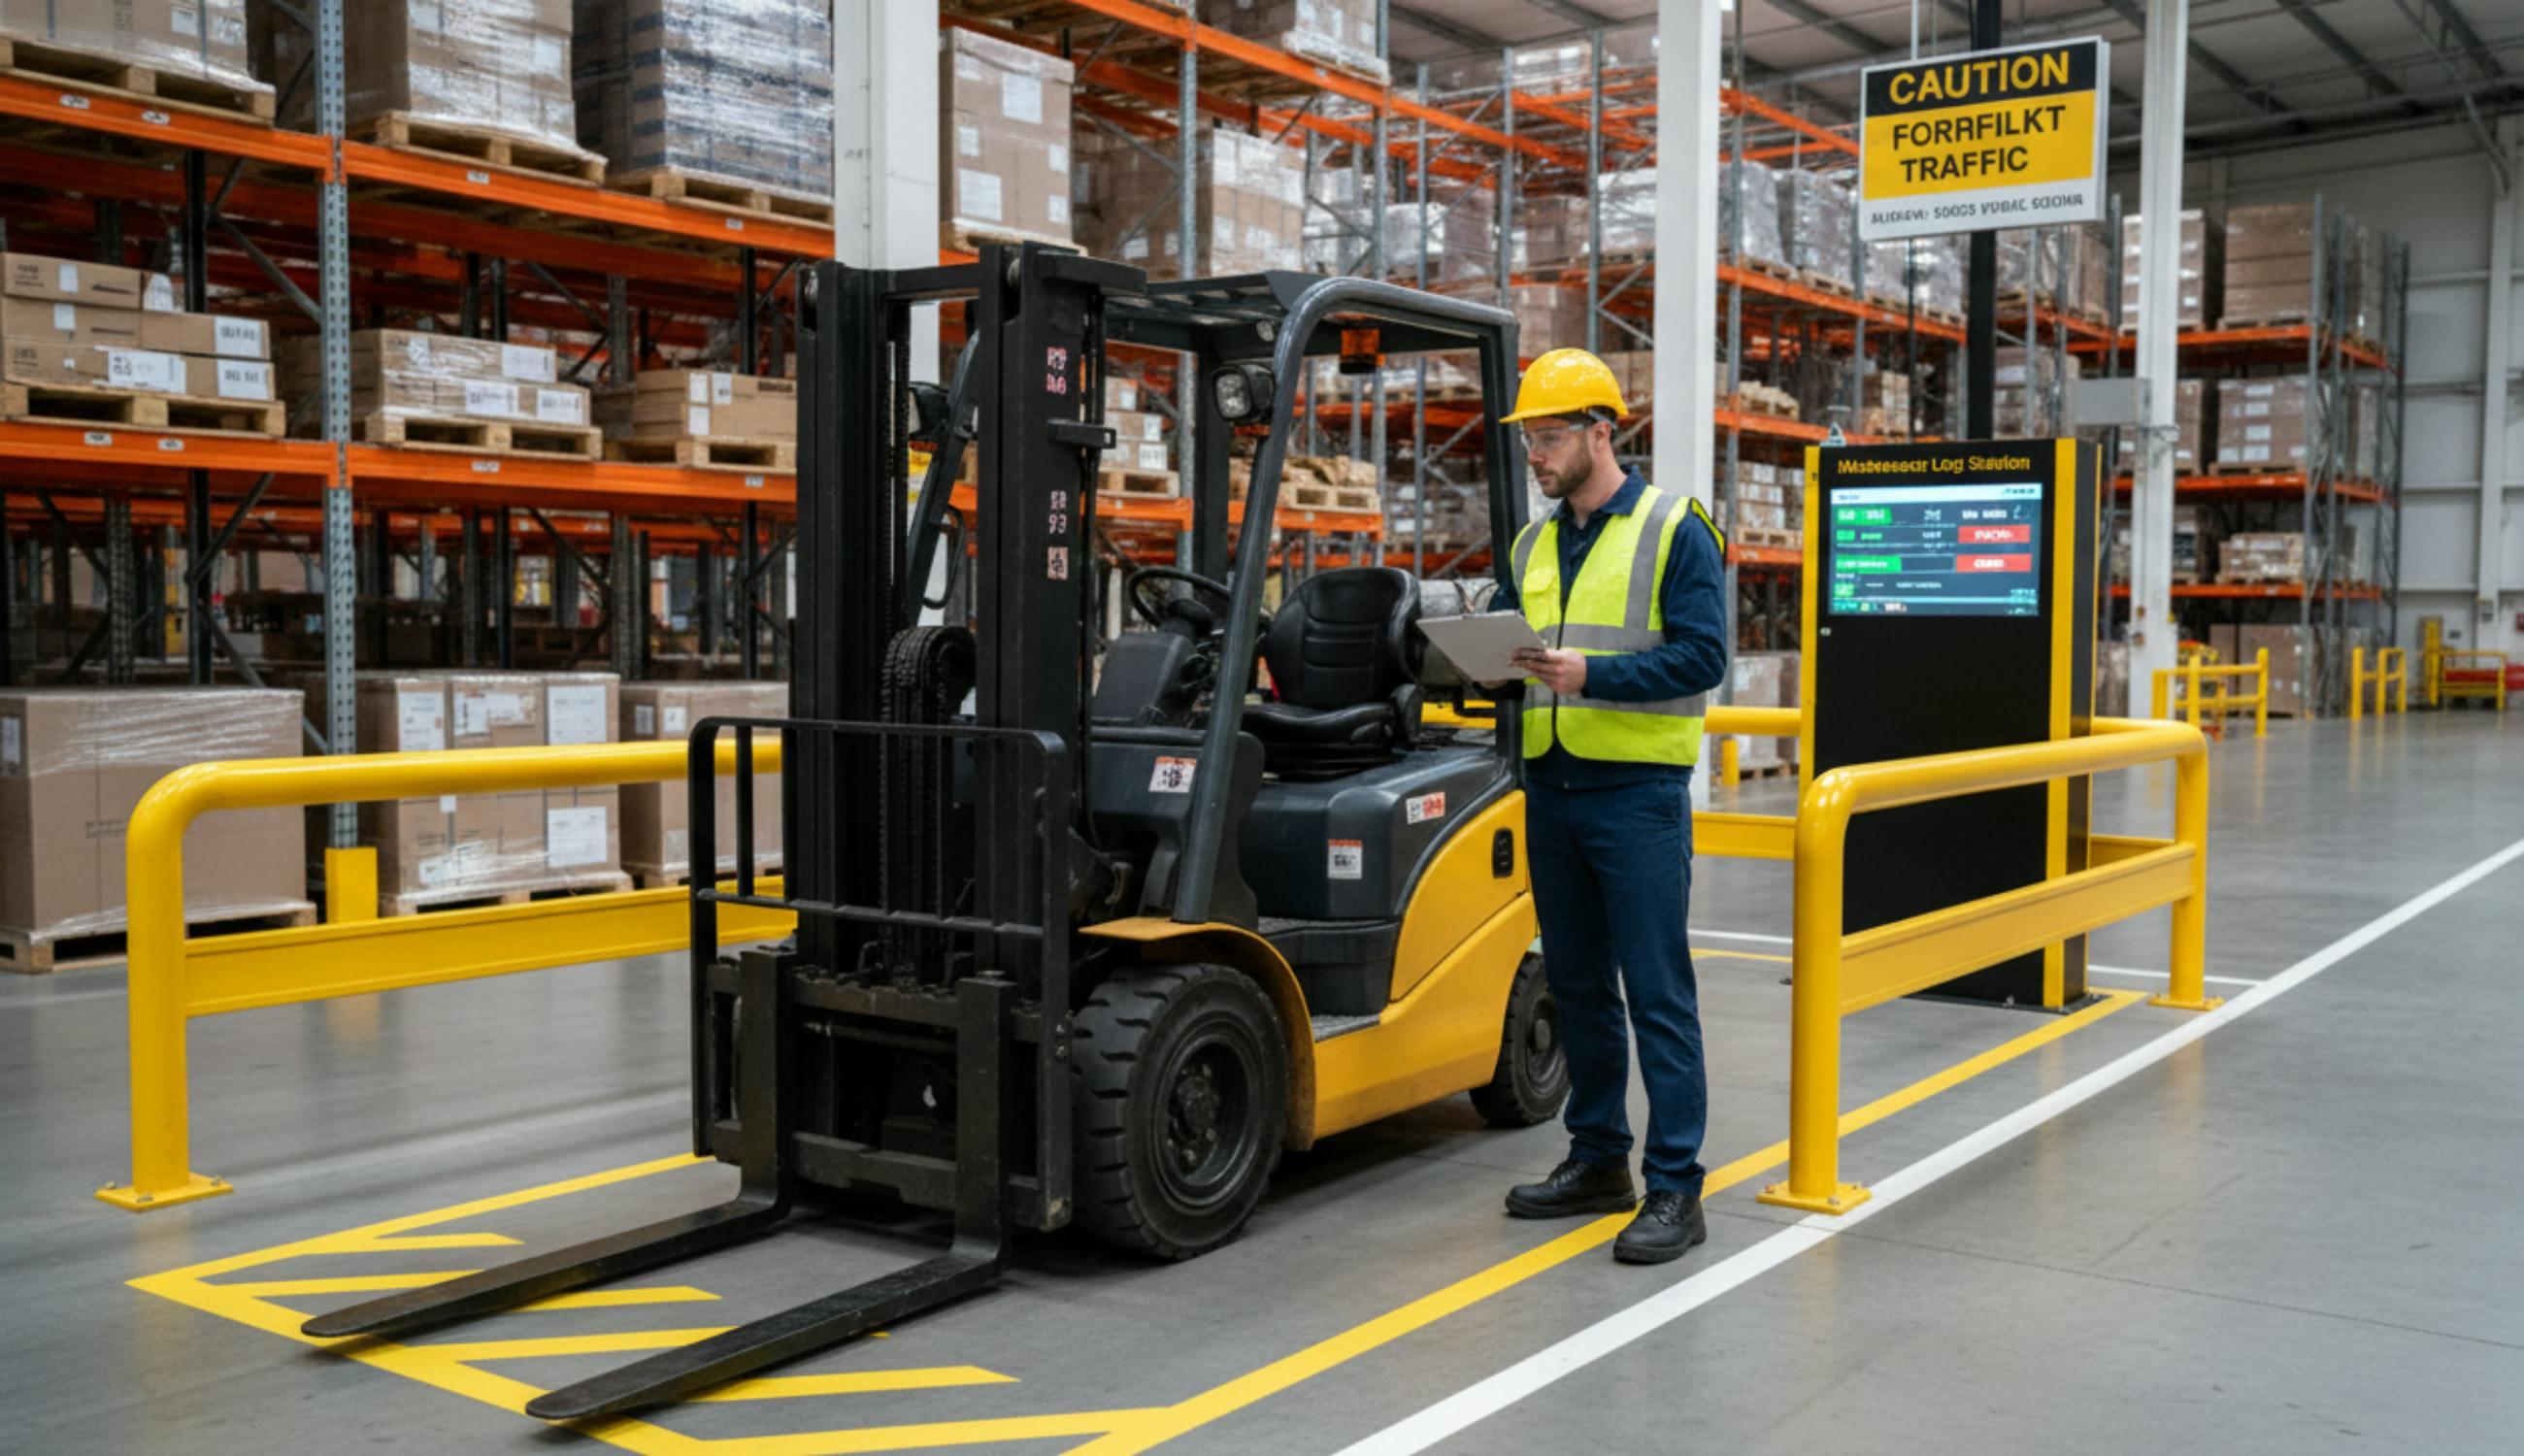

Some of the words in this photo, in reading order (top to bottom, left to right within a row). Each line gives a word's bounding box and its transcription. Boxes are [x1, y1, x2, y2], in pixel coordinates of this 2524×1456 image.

[1889, 50, 2069, 105] CAUTION
[1900, 146, 2028, 182] TRAFFIC
[1932, 457, 1964, 475] Log
